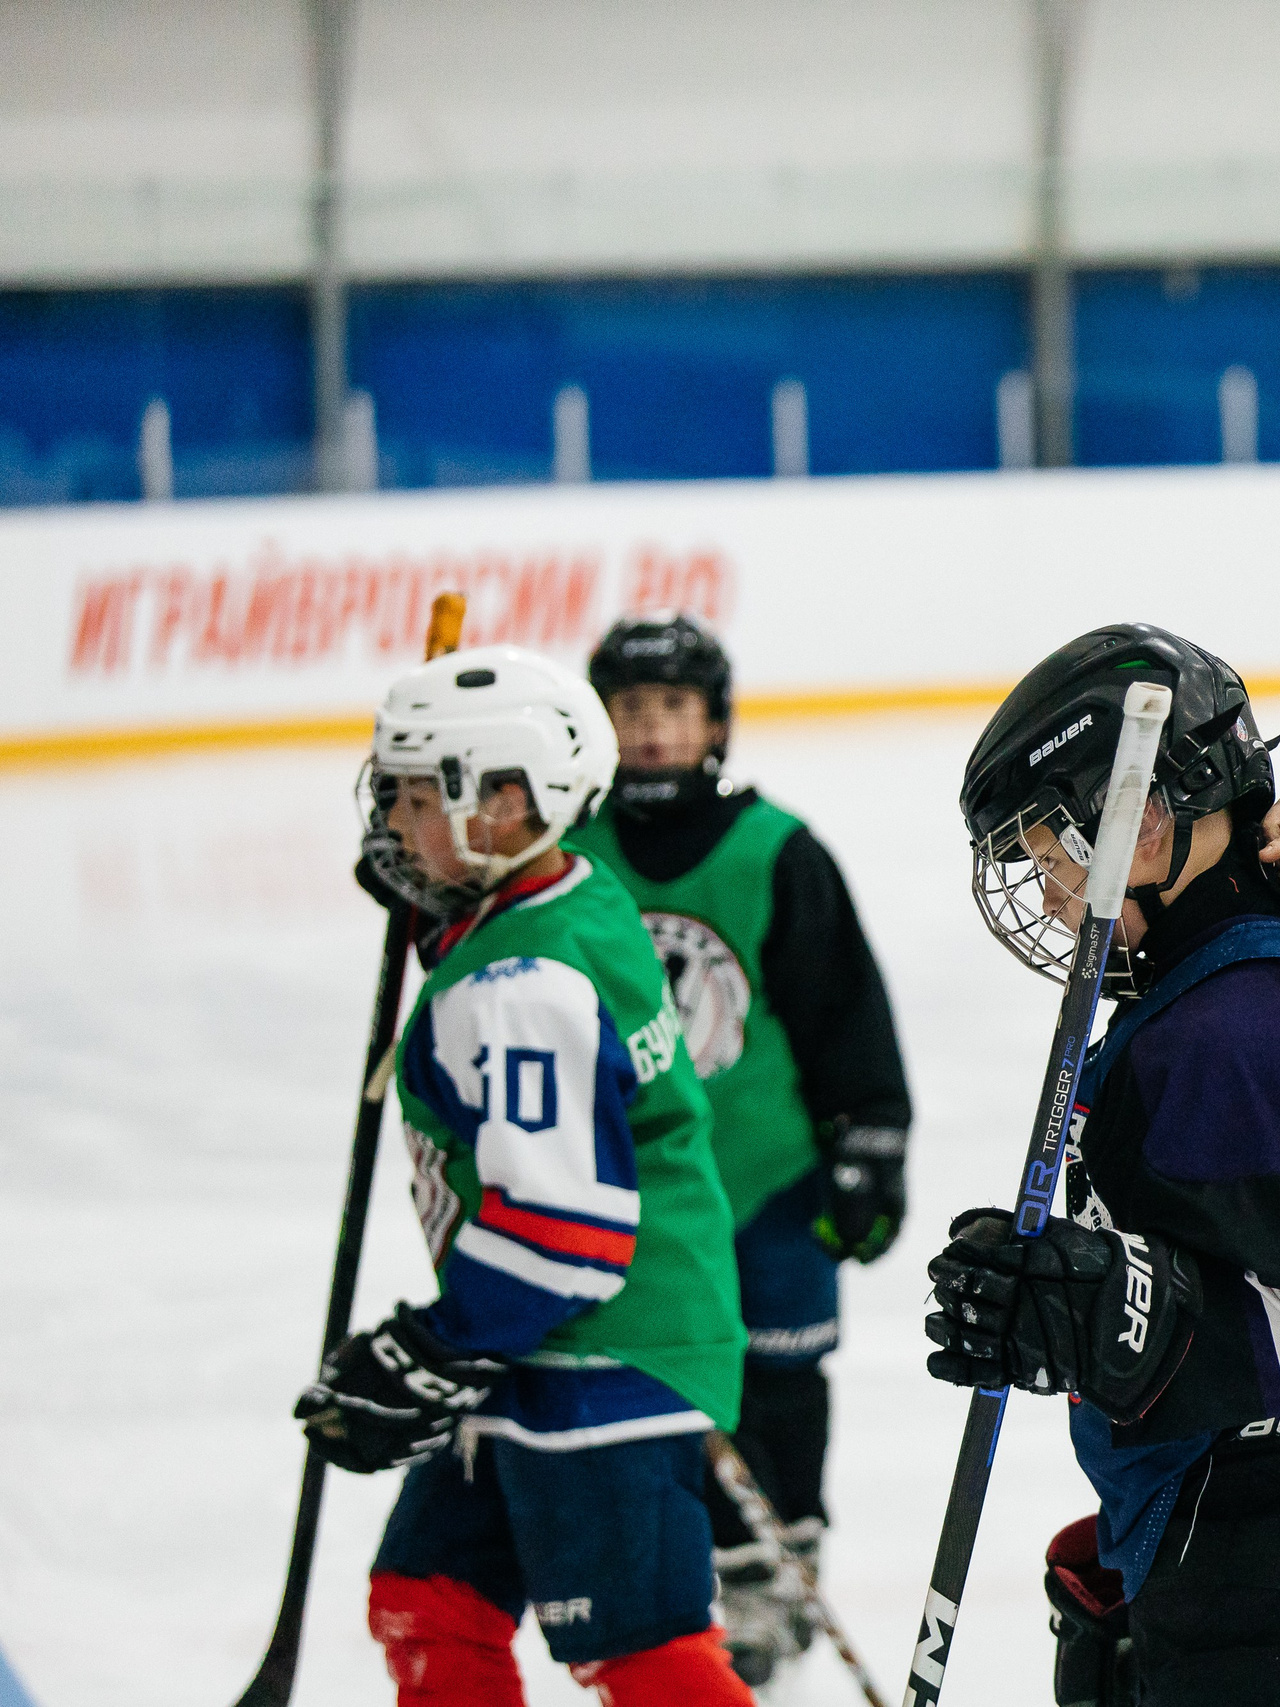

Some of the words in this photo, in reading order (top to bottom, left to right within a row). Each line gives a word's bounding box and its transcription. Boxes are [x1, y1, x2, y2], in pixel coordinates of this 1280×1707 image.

[1029, 713, 1094, 767] BAUER
[1042, 1069, 1073, 1153] TRIGGER
[1117, 1230, 1154, 1353] UER
